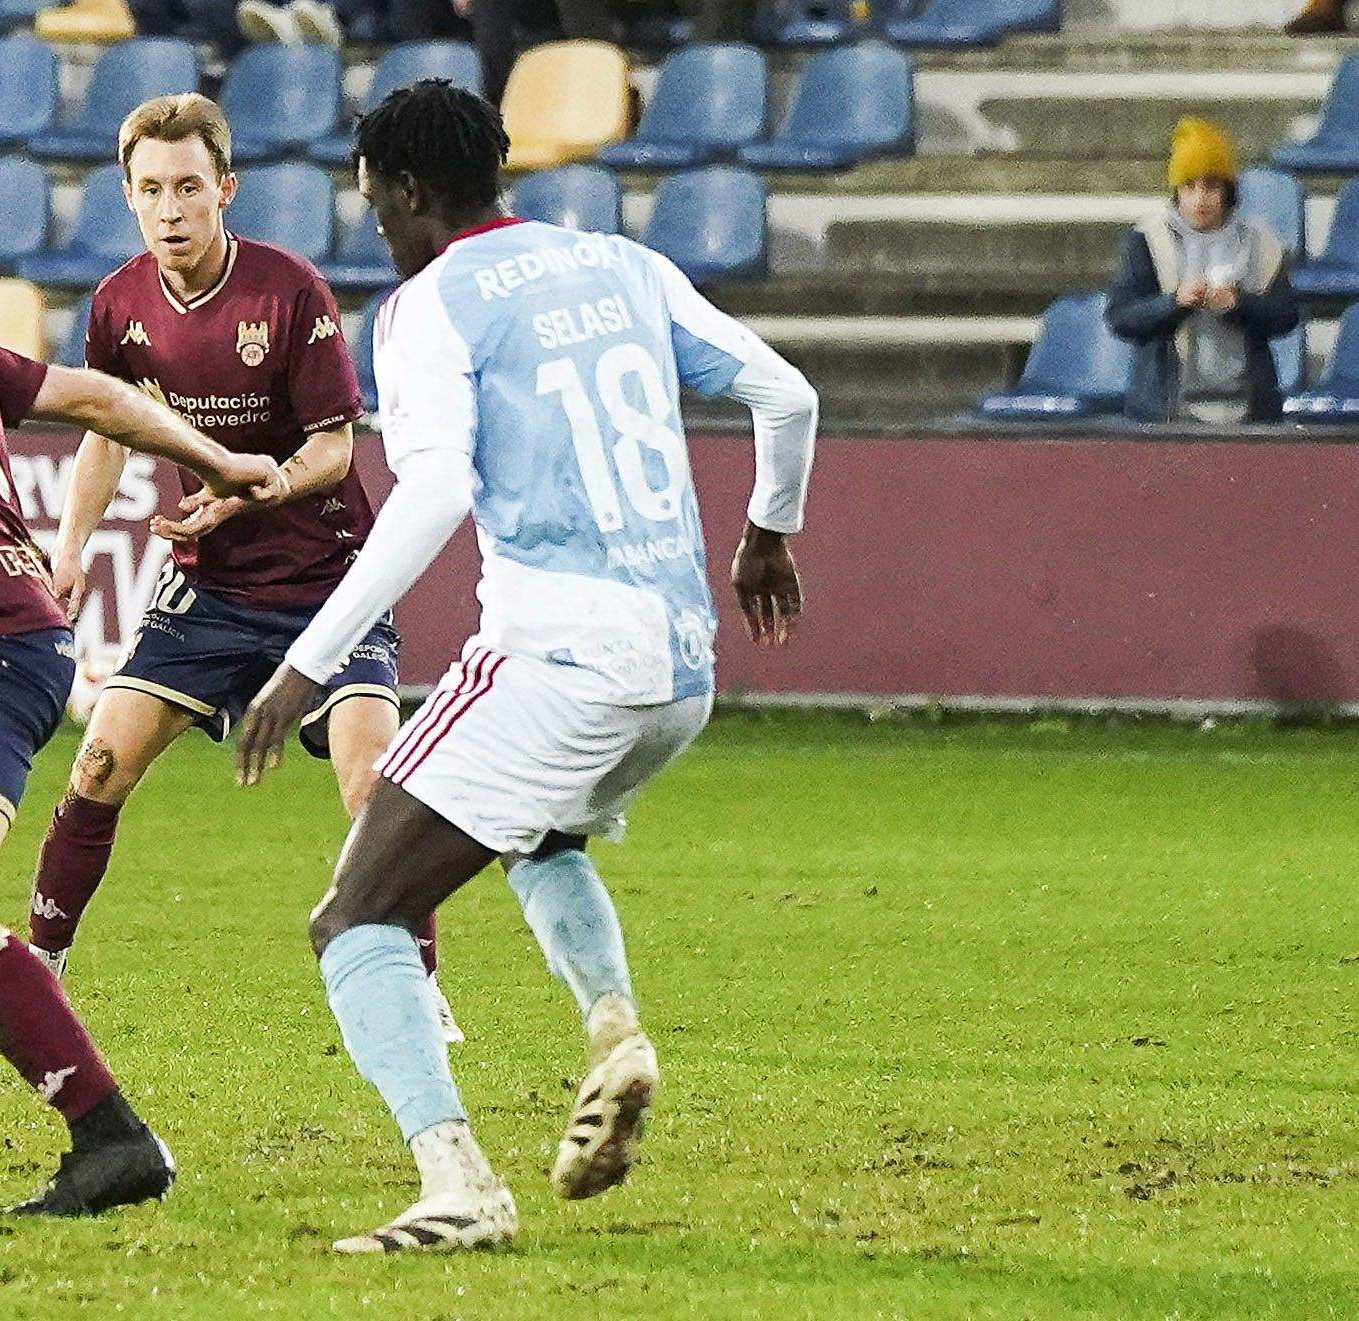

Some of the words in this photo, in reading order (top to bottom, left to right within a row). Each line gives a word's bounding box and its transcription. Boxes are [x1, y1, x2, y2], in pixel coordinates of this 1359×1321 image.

[533, 294, 633, 350] SELASI
[168, 392, 270, 413] Deputación
[535, 343, 691, 534] 18
